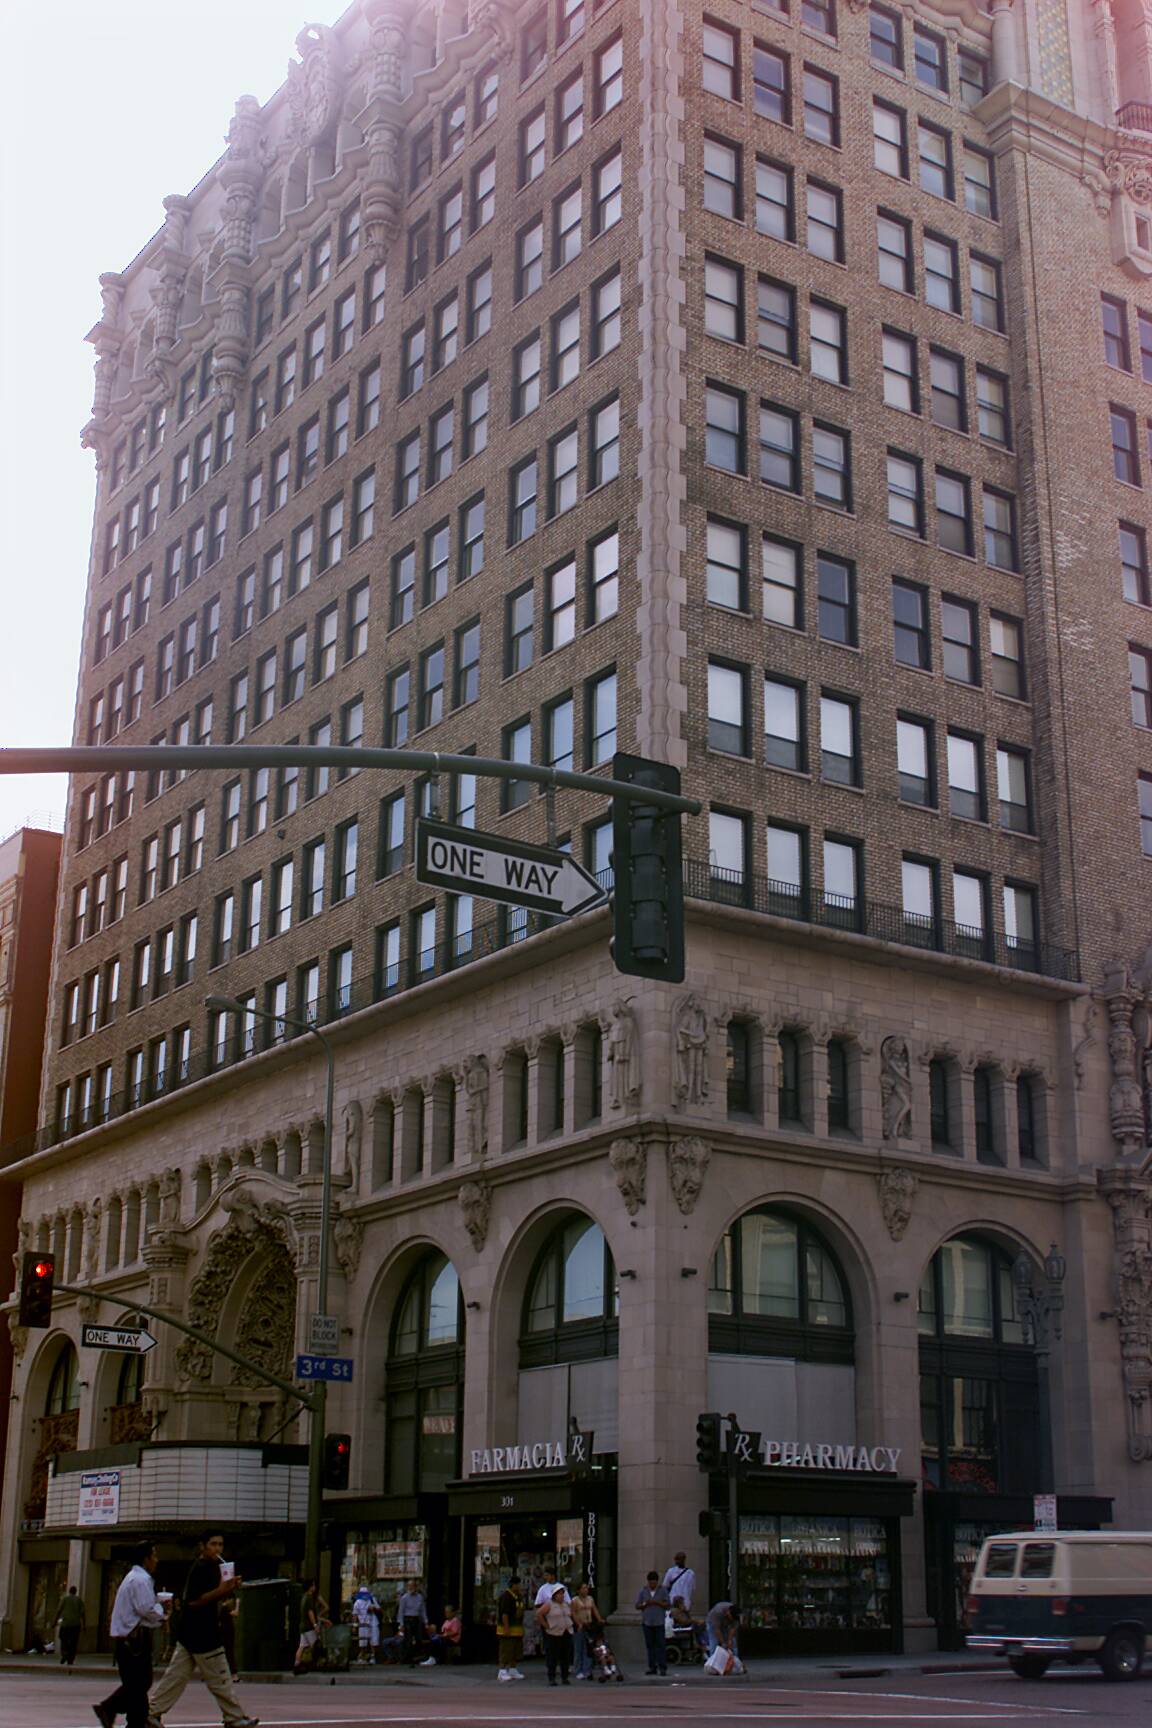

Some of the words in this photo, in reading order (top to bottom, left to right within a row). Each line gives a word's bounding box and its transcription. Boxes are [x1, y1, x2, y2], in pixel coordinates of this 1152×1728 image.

[430, 840, 485, 880] ONE
[504, 857, 559, 896] WAY
[312, 1317, 322, 1328] DO
[312, 1329, 337, 1341] BLOCK
[87, 1330, 110, 1344] ONE
[116, 1333, 140, 1346] WAY
[301, 1359, 327, 1377] 3rd
[331, 1362, 350, 1378] St
[471, 1441, 568, 1474] FARMACIA
[763, 1440, 901, 1473] PHARMACY
[587, 1511, 596, 1589] BOTICA
